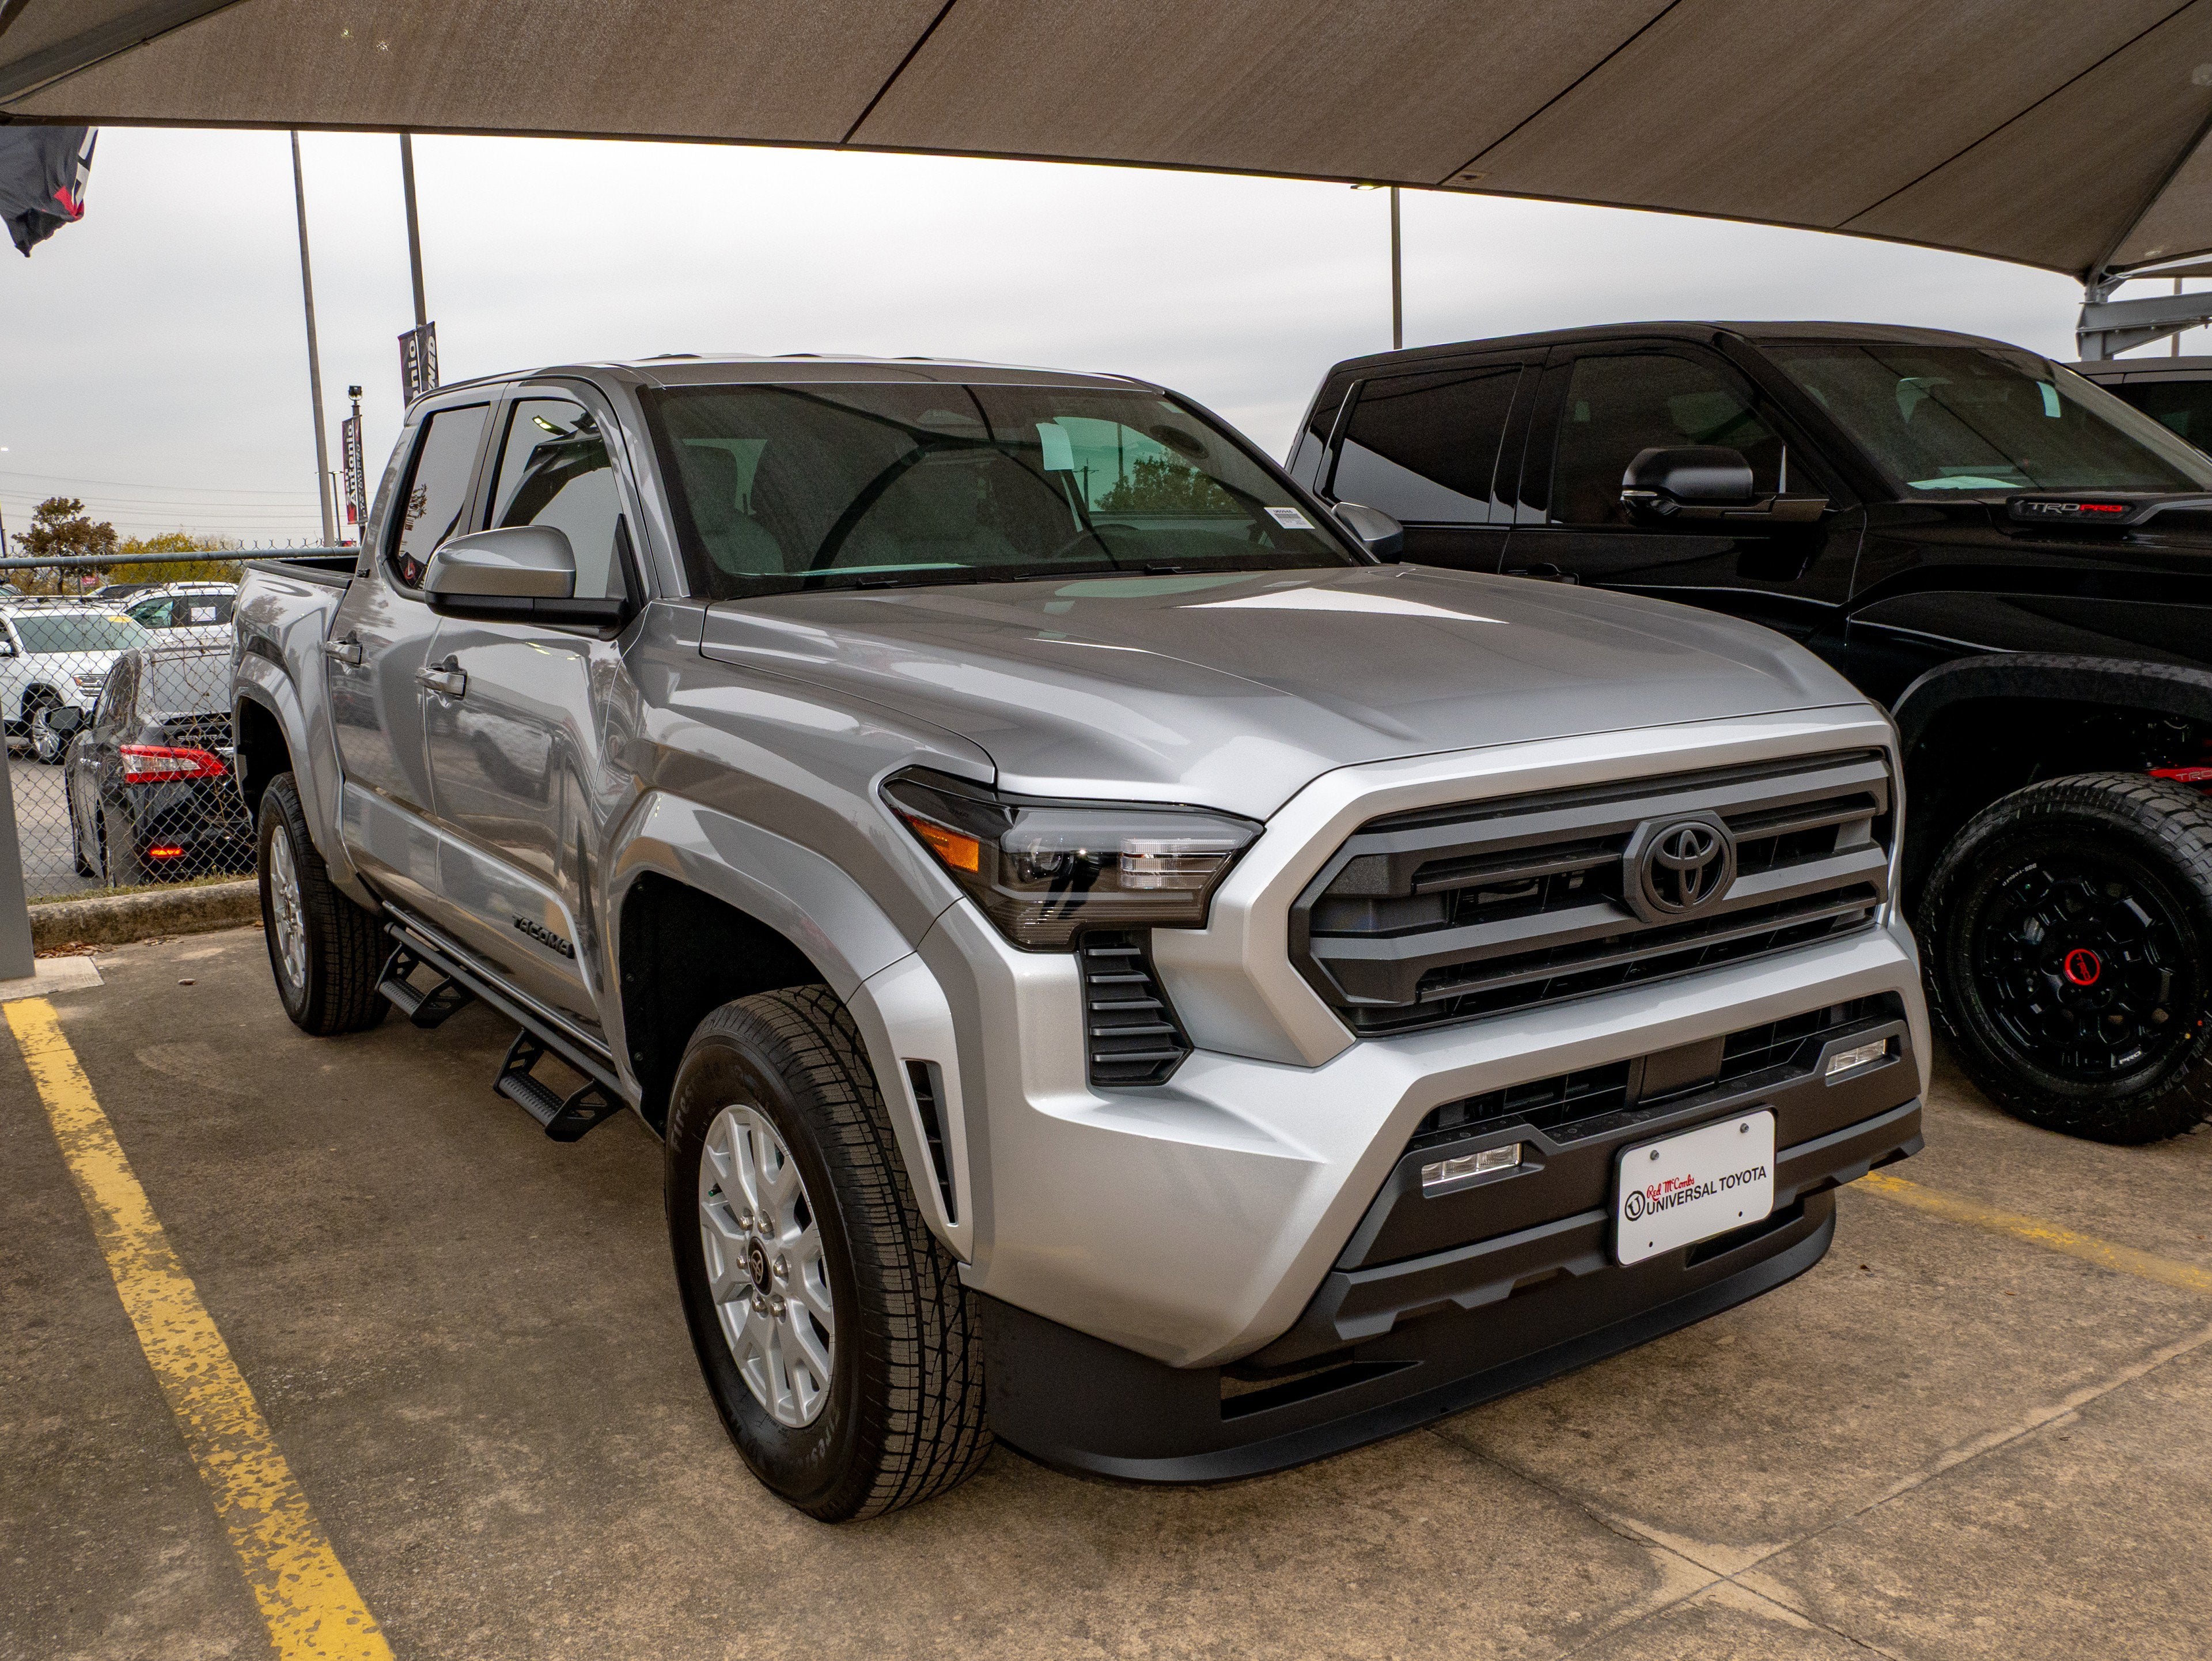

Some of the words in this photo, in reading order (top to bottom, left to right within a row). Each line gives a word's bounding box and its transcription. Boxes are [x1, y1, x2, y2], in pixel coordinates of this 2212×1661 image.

[346, 425, 357, 506] Antonio
[2027, 502, 2080, 514] TRD
[2080, 504, 2123, 513] PRO
[177, 734, 229, 742] SENTRA
[512, 912, 575, 959] TACOMA
[2119, 1050, 2142, 1065] PRO
[1646, 1185, 1664, 1202] Red
[1663, 1174, 1695, 1193] McCombs
[1646, 1181, 1717, 1215] UNIVERSAL
[1719, 1165, 1767, 1191] TOYOTA
